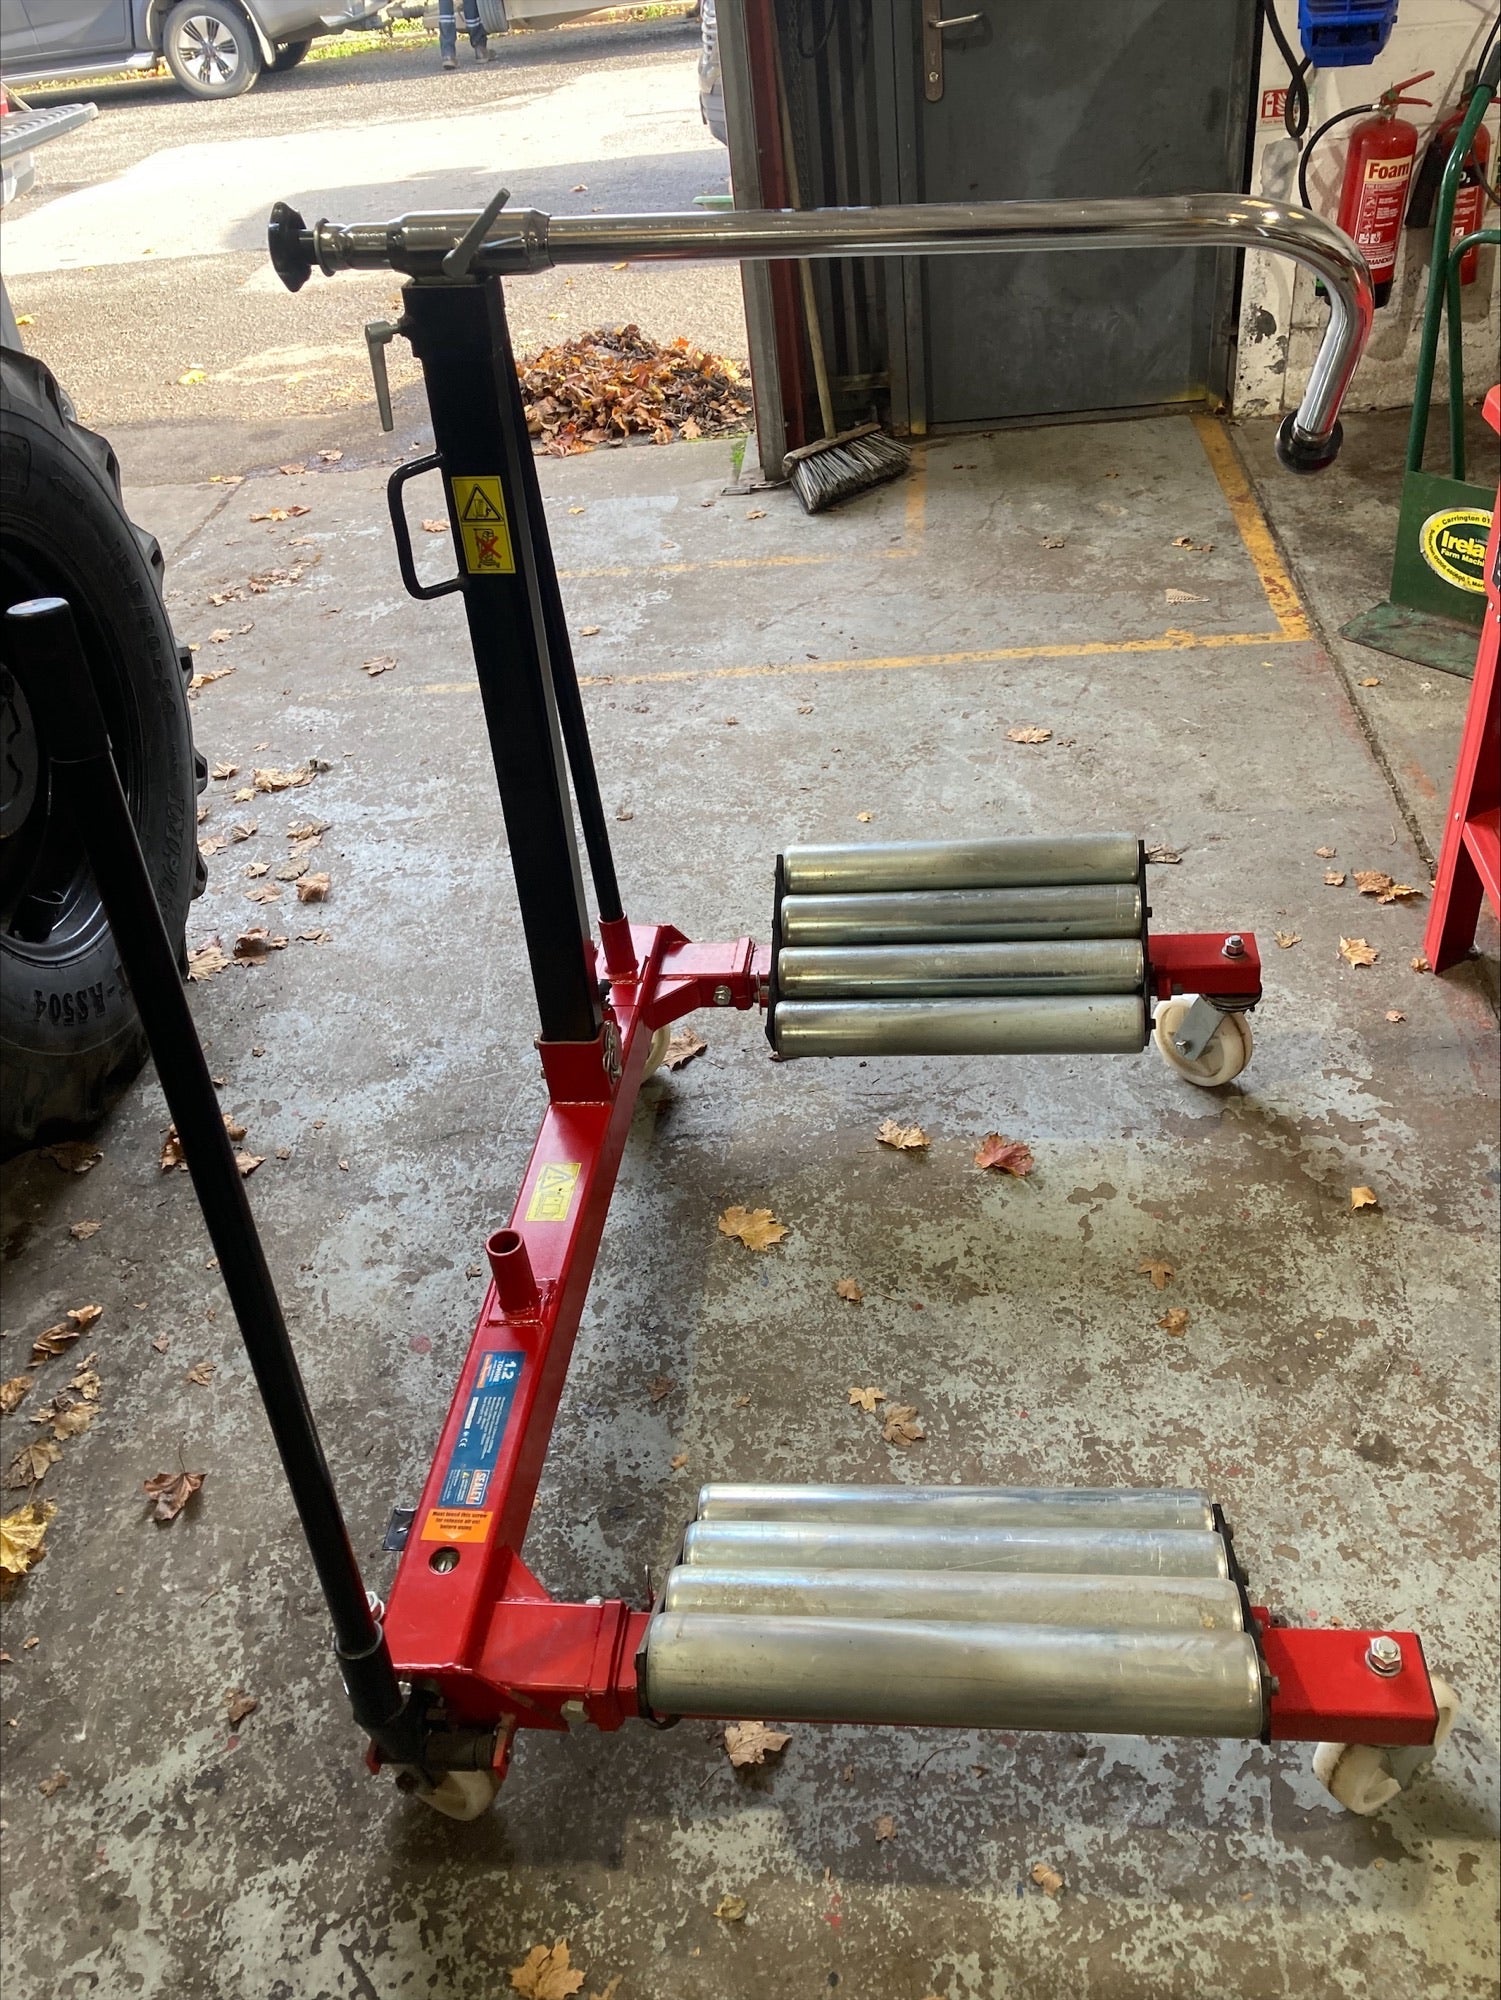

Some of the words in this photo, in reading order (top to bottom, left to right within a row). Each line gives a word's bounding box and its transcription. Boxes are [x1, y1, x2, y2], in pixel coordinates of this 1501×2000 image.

[1368, 162, 1410, 179] Foam
[1442, 515, 1480, 525] Carrington
[1441, 547, 1460, 560] Farm
[493, 1360, 504, 1382] TONNE
[501, 1361, 517, 1380] 1.2
[470, 1472, 487, 1501] SEALEY
